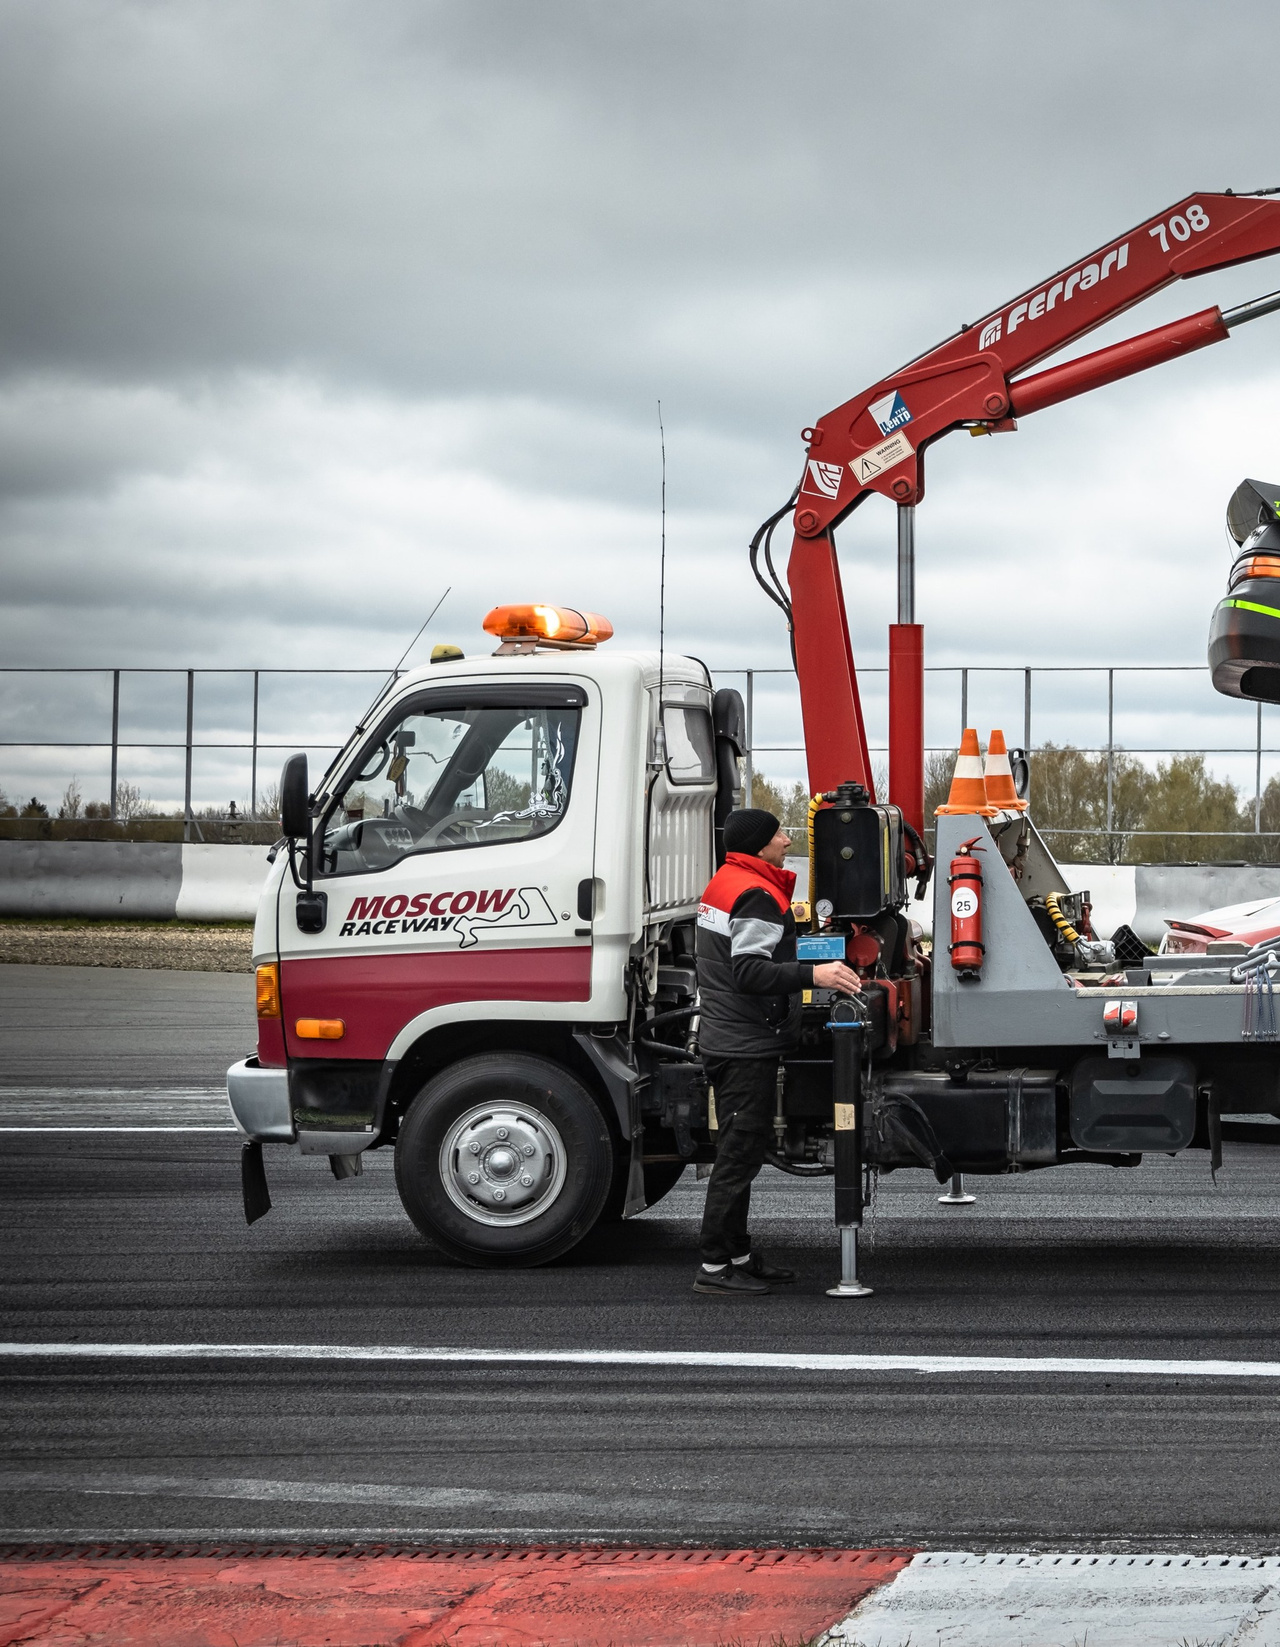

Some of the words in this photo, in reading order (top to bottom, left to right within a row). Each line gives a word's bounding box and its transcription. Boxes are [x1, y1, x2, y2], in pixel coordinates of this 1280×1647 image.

[1006, 243, 1129, 334] Ferrari
[1150, 204, 1210, 252] 708
[876, 439, 901, 456] WARNING
[346, 888, 517, 921] MOSCOW
[956, 901, 971, 912] 25
[338, 916, 455, 937] RACEWAY
